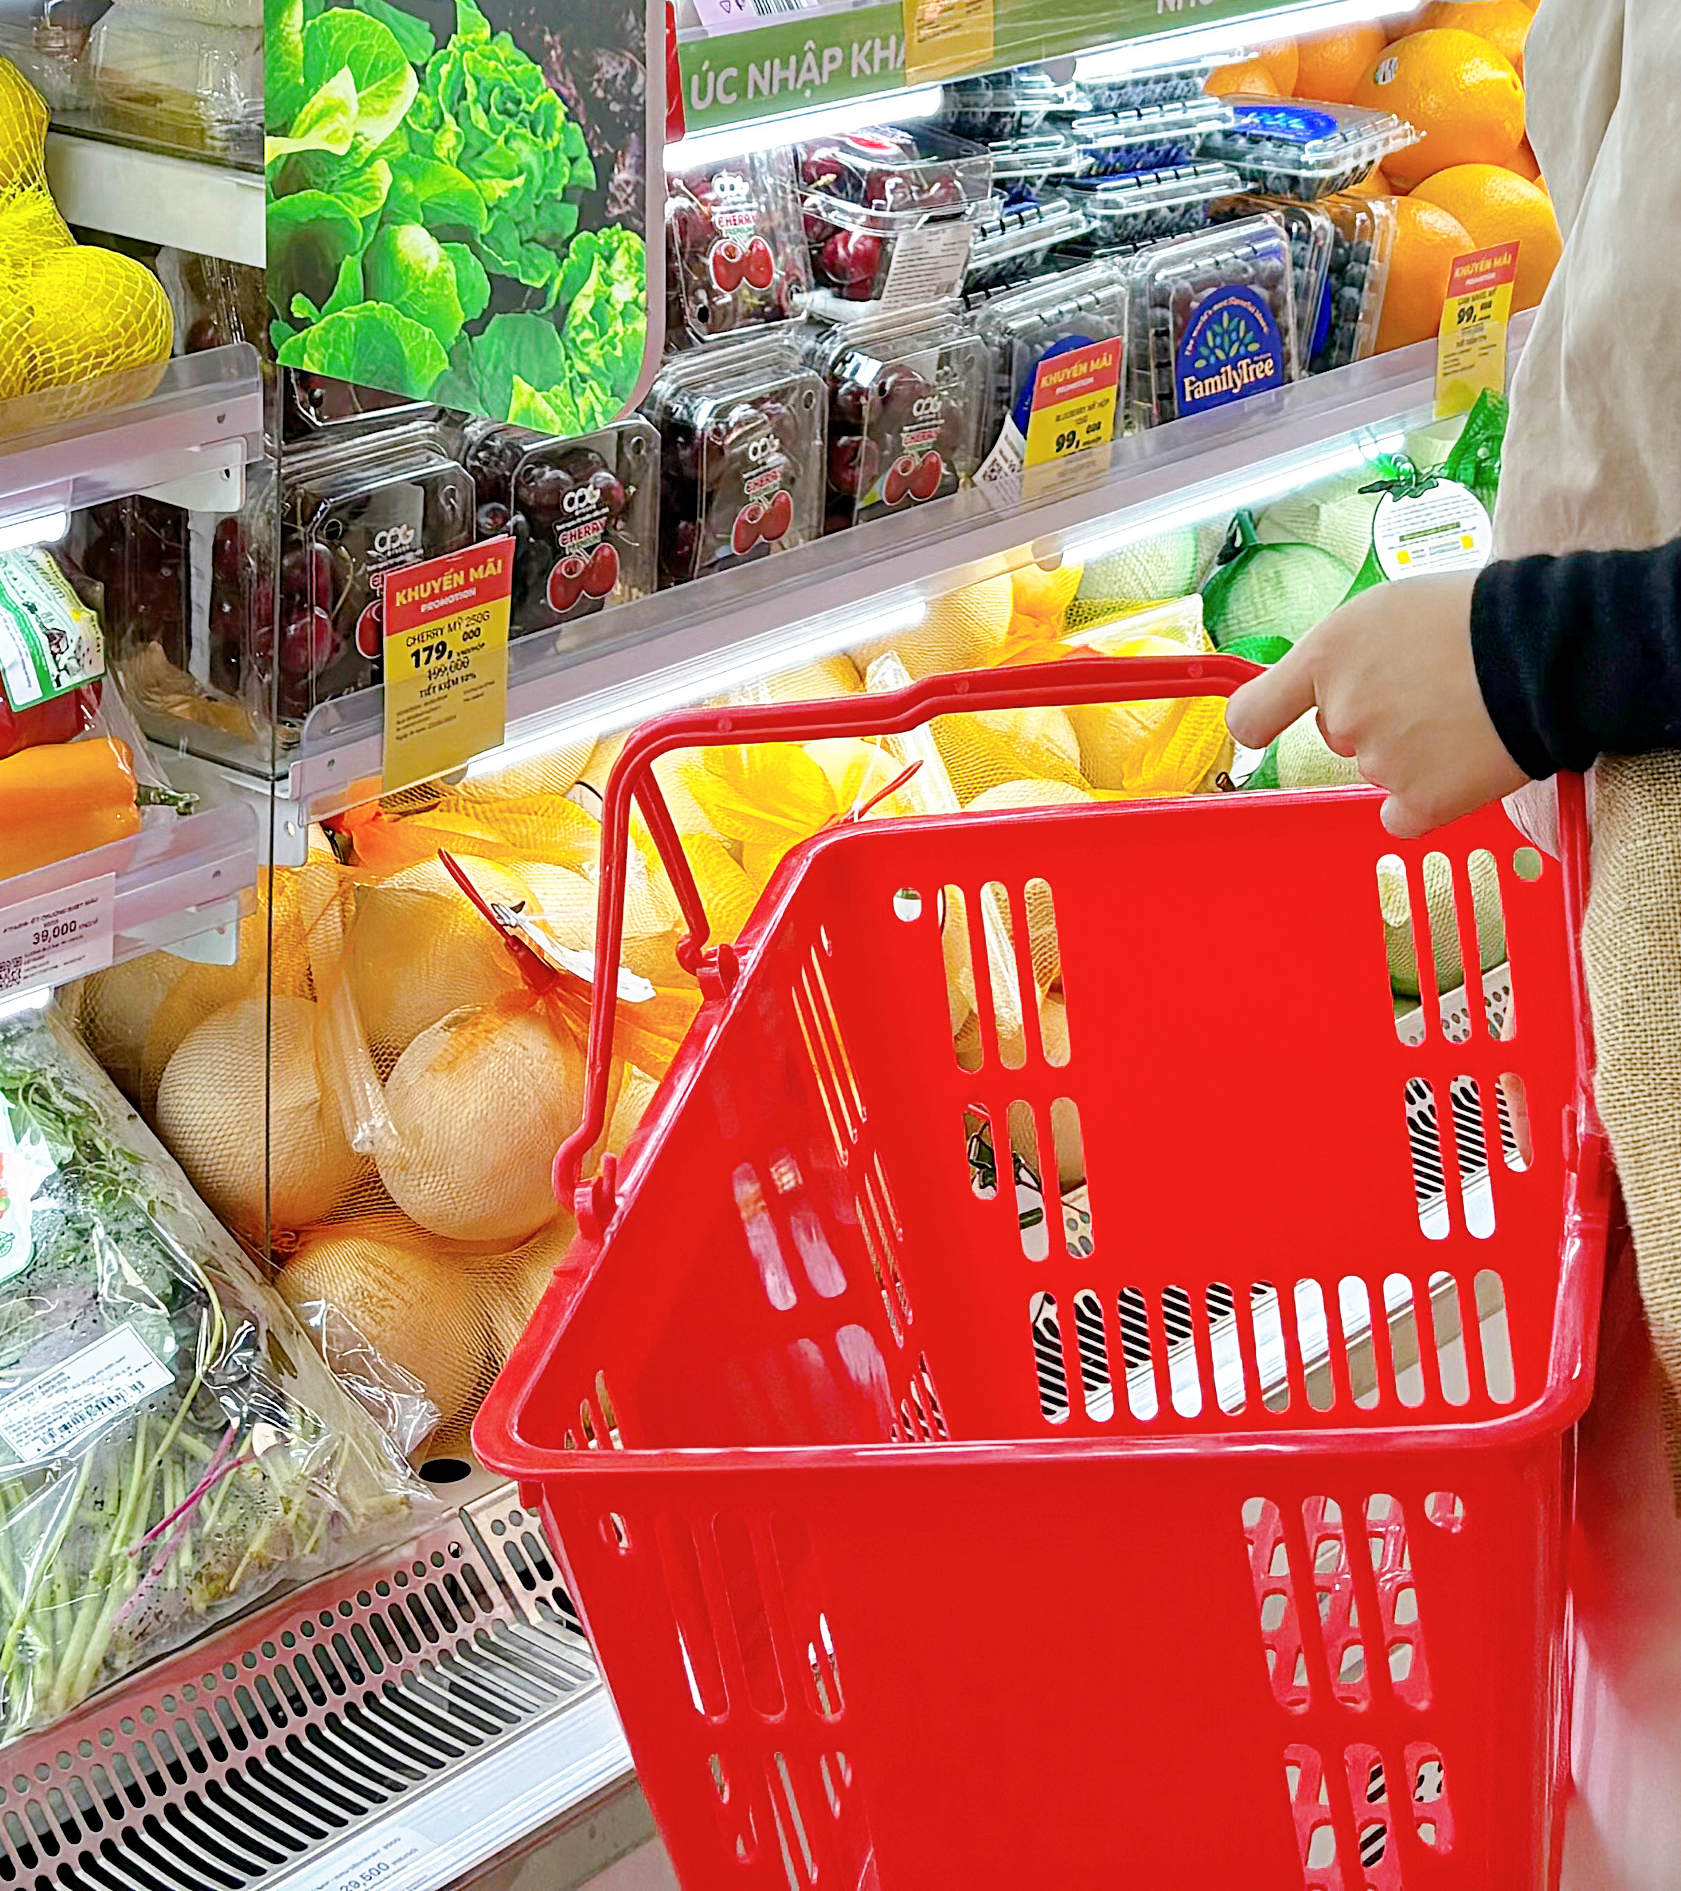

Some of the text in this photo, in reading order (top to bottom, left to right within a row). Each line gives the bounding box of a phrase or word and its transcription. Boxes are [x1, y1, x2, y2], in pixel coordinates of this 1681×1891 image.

[691, 40, 842, 109] ÚC NHẬP
[1492, 253, 1512, 268] MÃI
[1040, 352, 1112, 388] KHUYẾN MÃI
[1183, 357, 1274, 402] FamilyTree
[1055, 429, 1080, 453] 99,
[394, 557, 503, 606] KHUYẾN MÃI
[420, 587, 477, 613] PROMOTION
[405, 624, 445, 648] CHERRY
[410, 627, 481, 668] 179, 000
